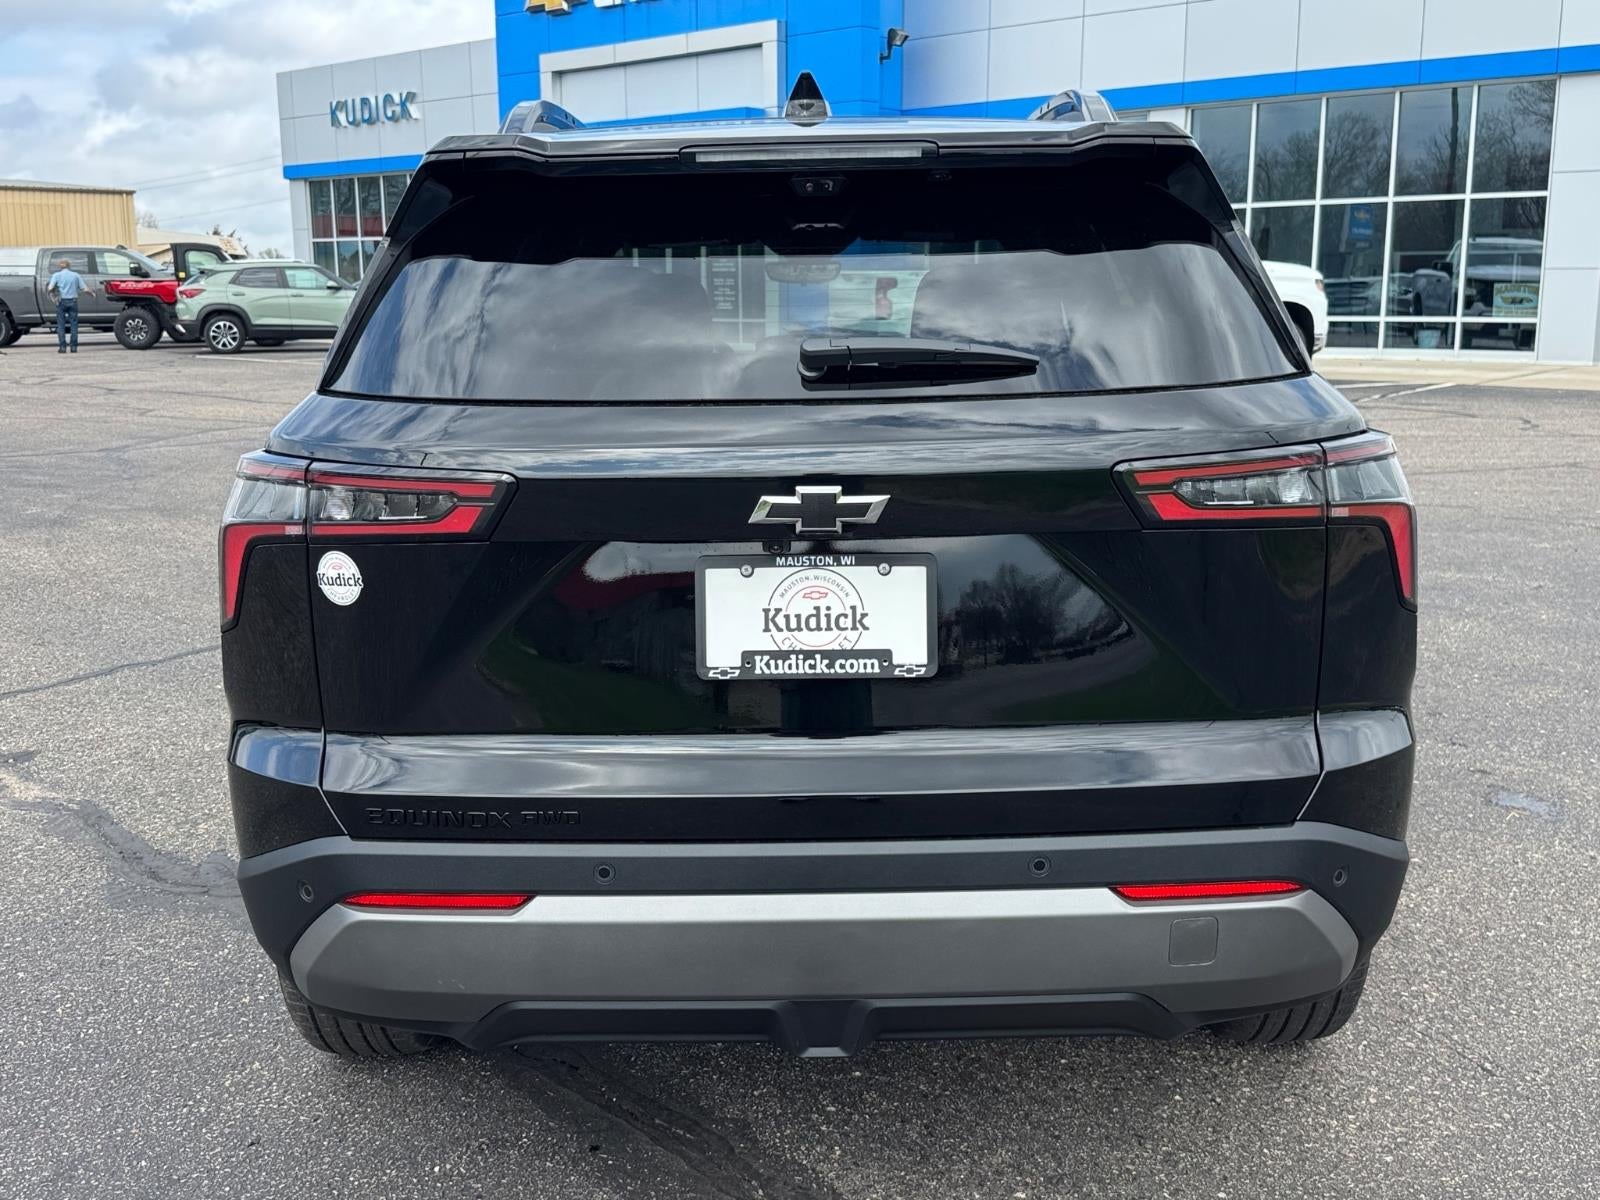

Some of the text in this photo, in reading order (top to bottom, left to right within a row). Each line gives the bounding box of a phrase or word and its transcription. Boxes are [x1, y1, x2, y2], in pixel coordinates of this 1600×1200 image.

[329, 91, 419, 128] KUDICK
[776, 556, 855, 566] MAUSTON, WI
[317, 572, 363, 587] Kudick
[813, 575, 850, 598] WISCONSIN
[761, 605, 870, 633] Kudick
[754, 654, 880, 674] Kudick.com
[365, 807, 512, 829] EQUINOX
